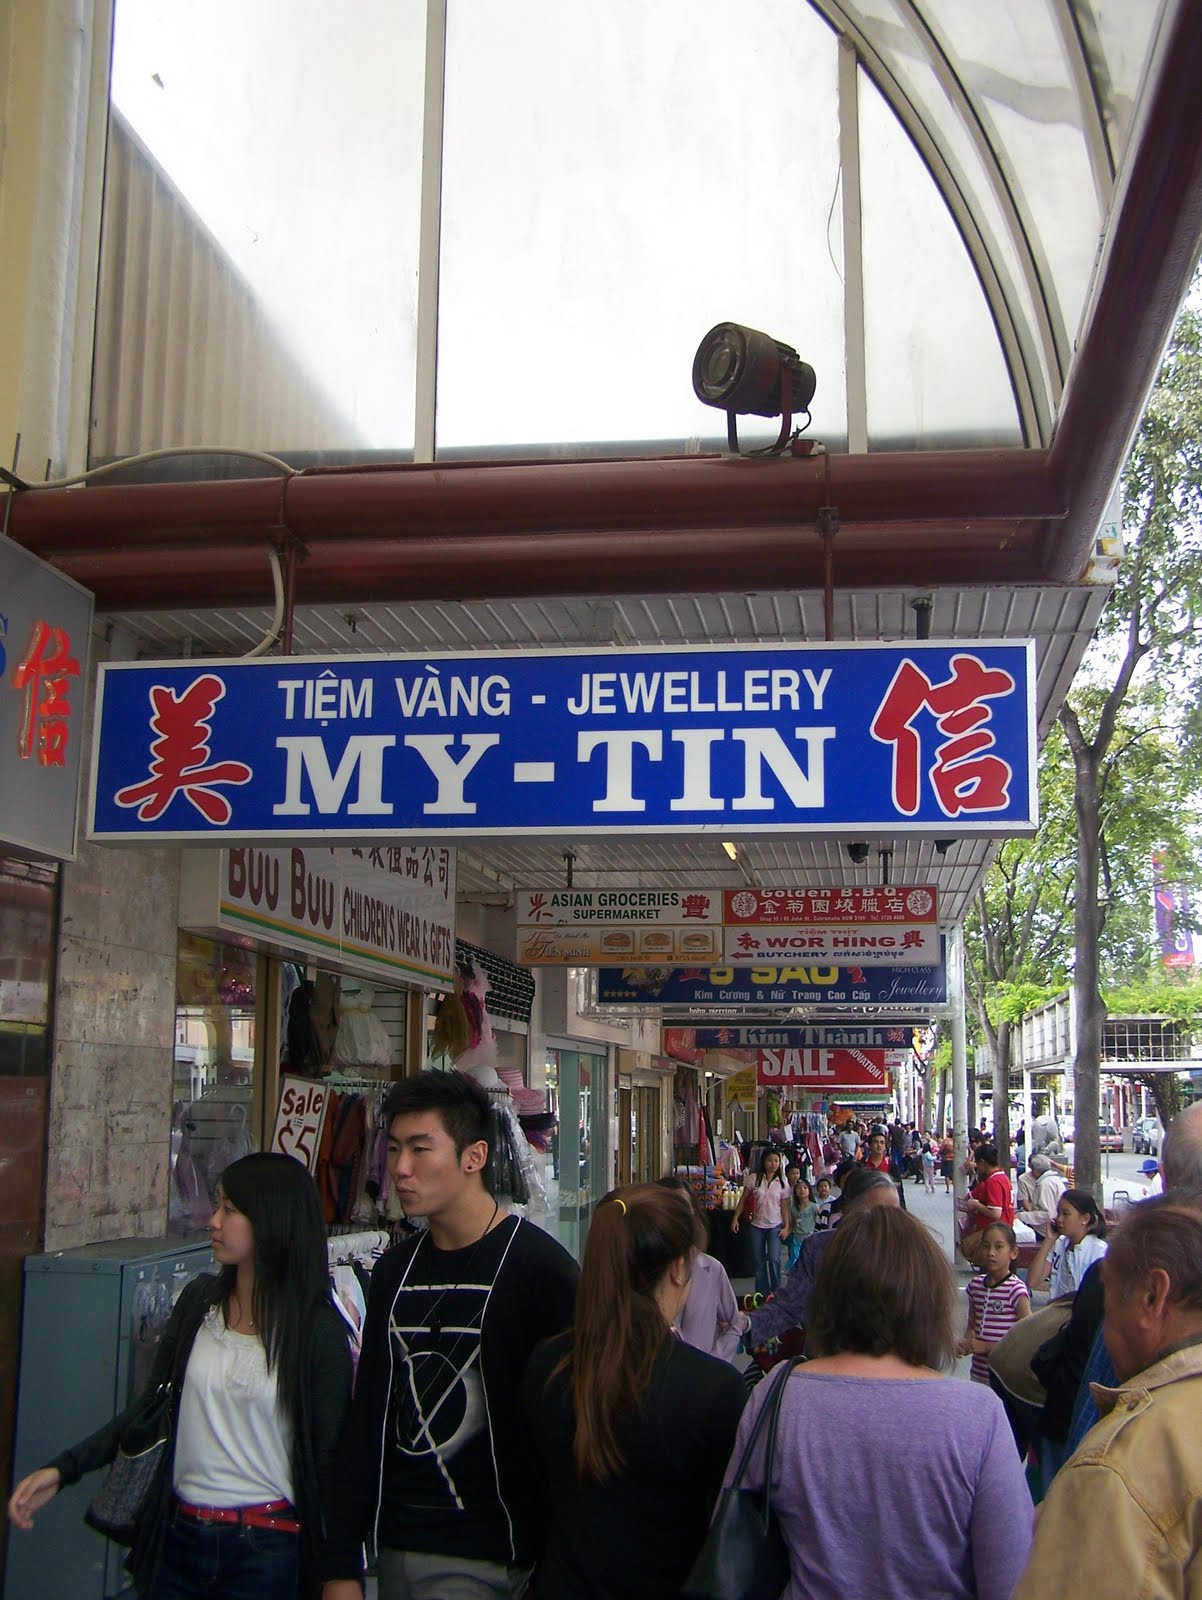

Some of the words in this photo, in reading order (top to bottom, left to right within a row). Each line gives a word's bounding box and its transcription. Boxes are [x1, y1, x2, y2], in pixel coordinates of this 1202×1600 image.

[12, 618, 80, 768] 信
[278, 668, 374, 722] TIỆM
[395, 661, 511, 721] VÀNG
[567, 667, 833, 717] JEWELLERY
[113, 672, 254, 826] 美
[869, 652, 1016, 820] 信
[551, 893, 593, 907] ASIAN
[598, 892, 679, 907] GROCERIES
[761, 888, 832, 898] Golden
[840, 887, 904, 897] B.B.Q.
[343, 885, 395, 951] CHILDREN'S
[397, 909, 420, 959] WEAR
[430, 922, 451, 969] GIFTS
[573, 909, 661, 920] SUPERMARKET
[737, 931, 761, 951] 和
[766, 937, 825, 948] WOR
[832, 936, 896, 948] HING
[694, 990, 713, 1000] Kim
[756, 990, 765, 1000] &
[791, 990, 822, 1002] Trang
[827, 990, 846, 1000] Cao
[878, 976, 943, 1002] Jewellery
[739, 1028, 790, 1045] Kim
[800, 1028, 884, 1045] Thành
[762, 1048, 836, 1076] SALE
[281, 1087, 324, 1116] Sale
